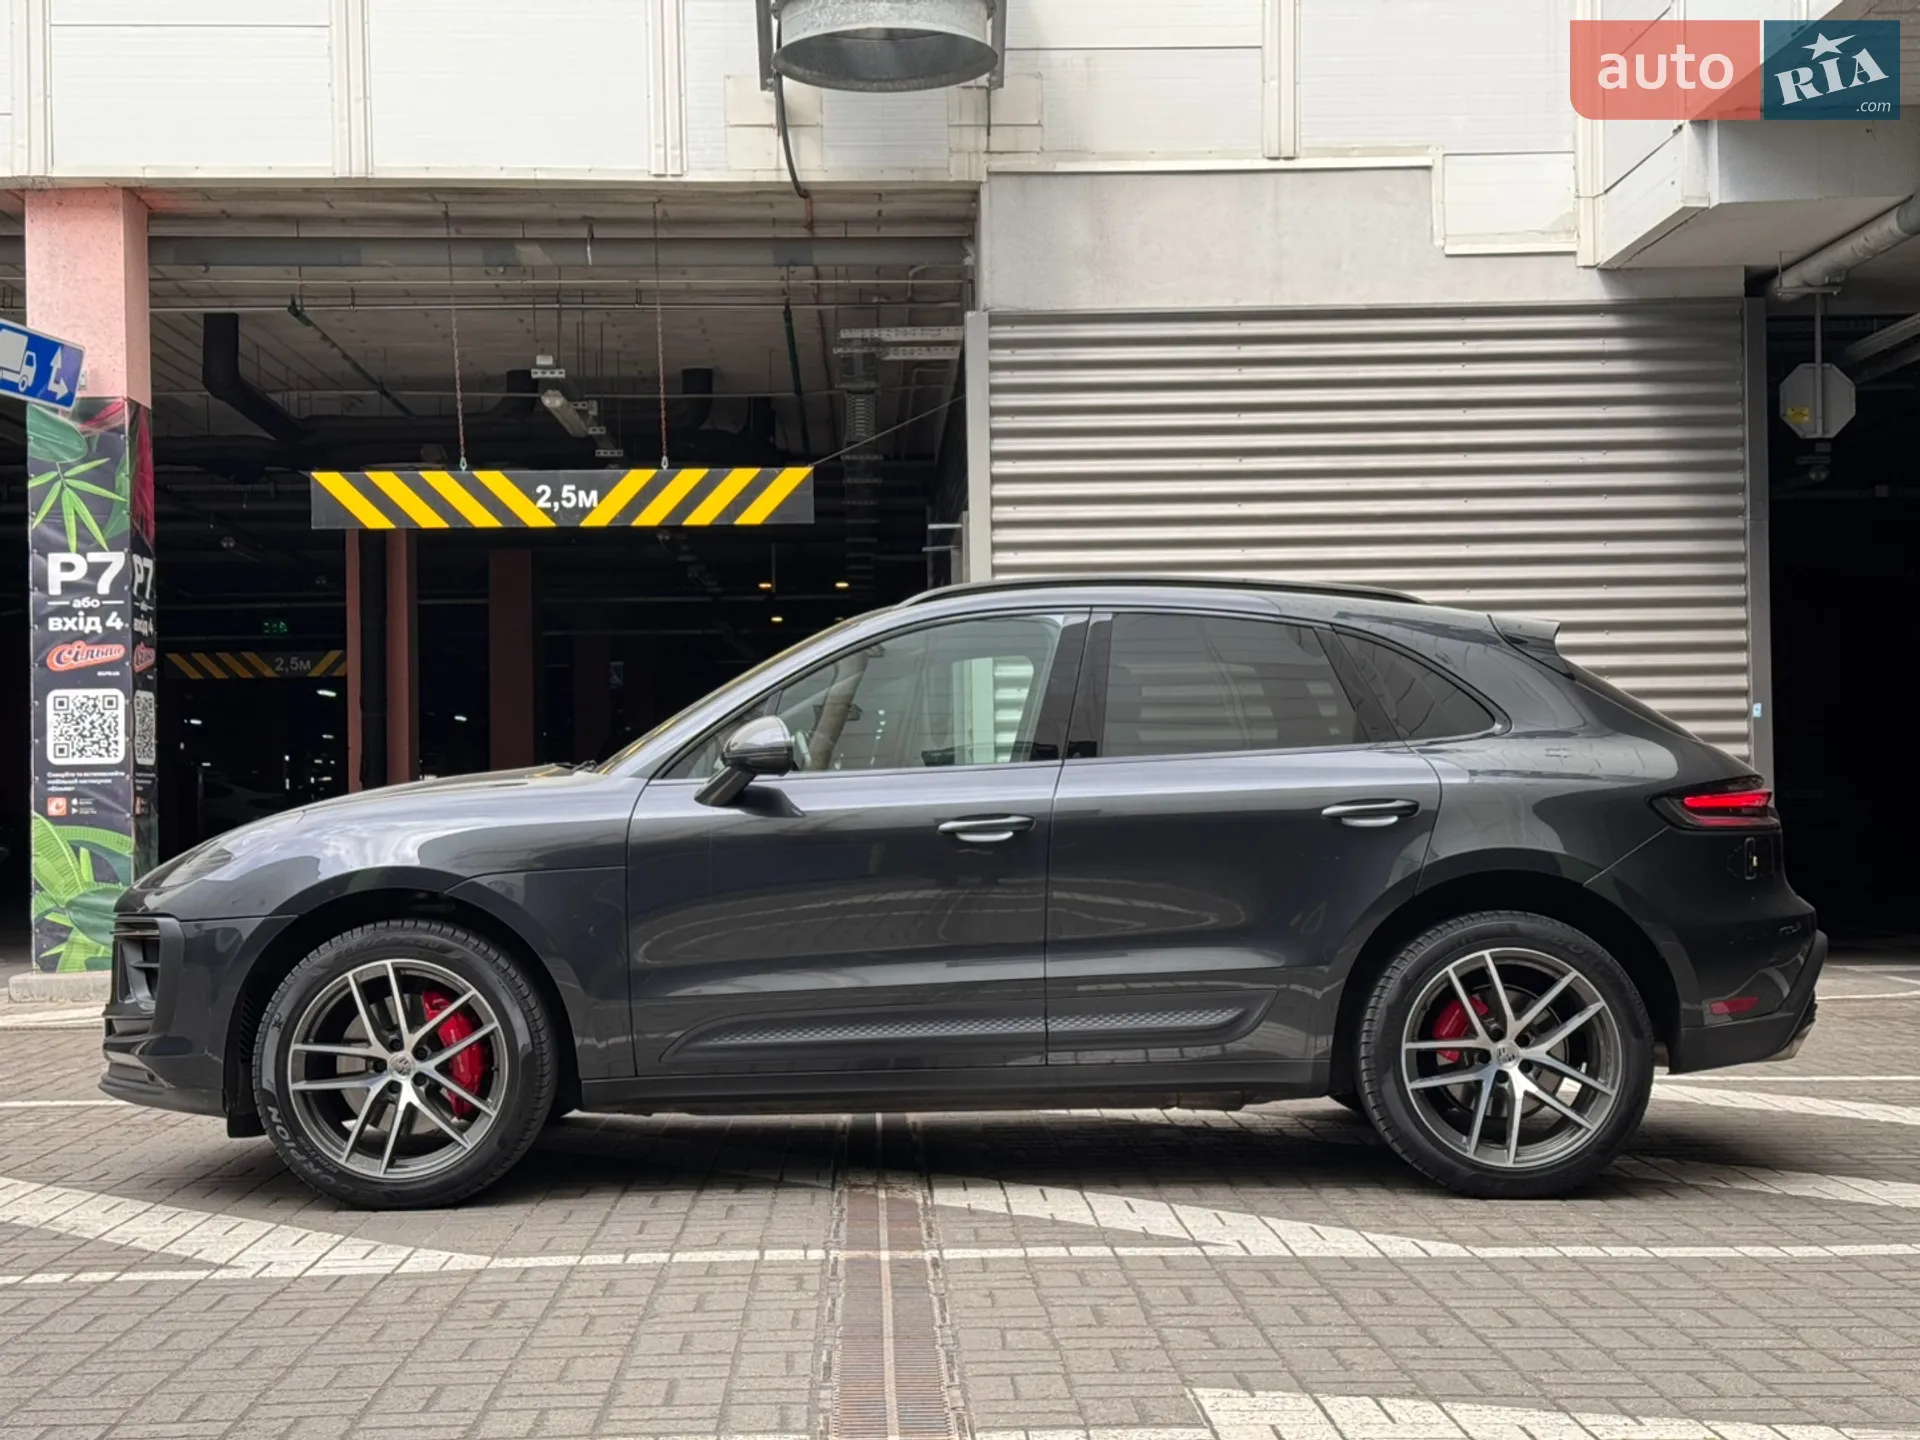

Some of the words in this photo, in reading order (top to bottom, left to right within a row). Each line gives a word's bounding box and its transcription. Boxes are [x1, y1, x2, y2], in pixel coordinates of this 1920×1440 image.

[47, 551, 125, 596] P7
[132, 553, 154, 600] P7
[72, 596, 101, 609] або
[48, 610, 103, 634] вхід
[105, 611, 124, 631] 4
